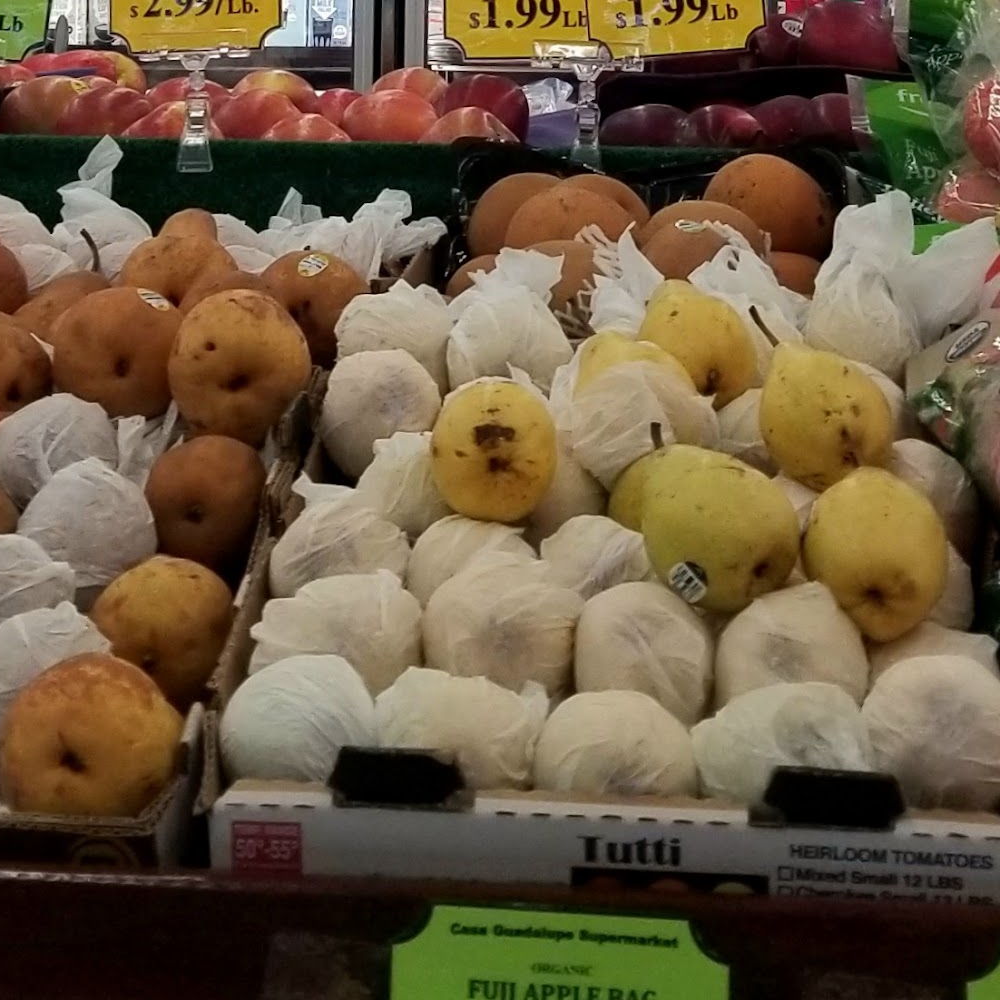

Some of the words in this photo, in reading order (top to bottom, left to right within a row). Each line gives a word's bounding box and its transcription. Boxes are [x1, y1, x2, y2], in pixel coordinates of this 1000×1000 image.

[790, 844, 887, 863] HEIRLOOM
[891, 850, 994, 870] TOMATOES
[796, 867, 846, 882] Mixed
[851, 871, 898, 886] Small
[903, 874, 923, 888] 12
[927, 875, 964, 890] LBS
[450, 922, 487, 936] Casa
[493, 924, 574, 942] Guadalupe
[578, 929, 679, 949] Supermarket
[530, 962, 593, 977] ORGANIC
[467, 979, 517, 1000] FUJI
[524, 983, 601, 1000] APPLE
